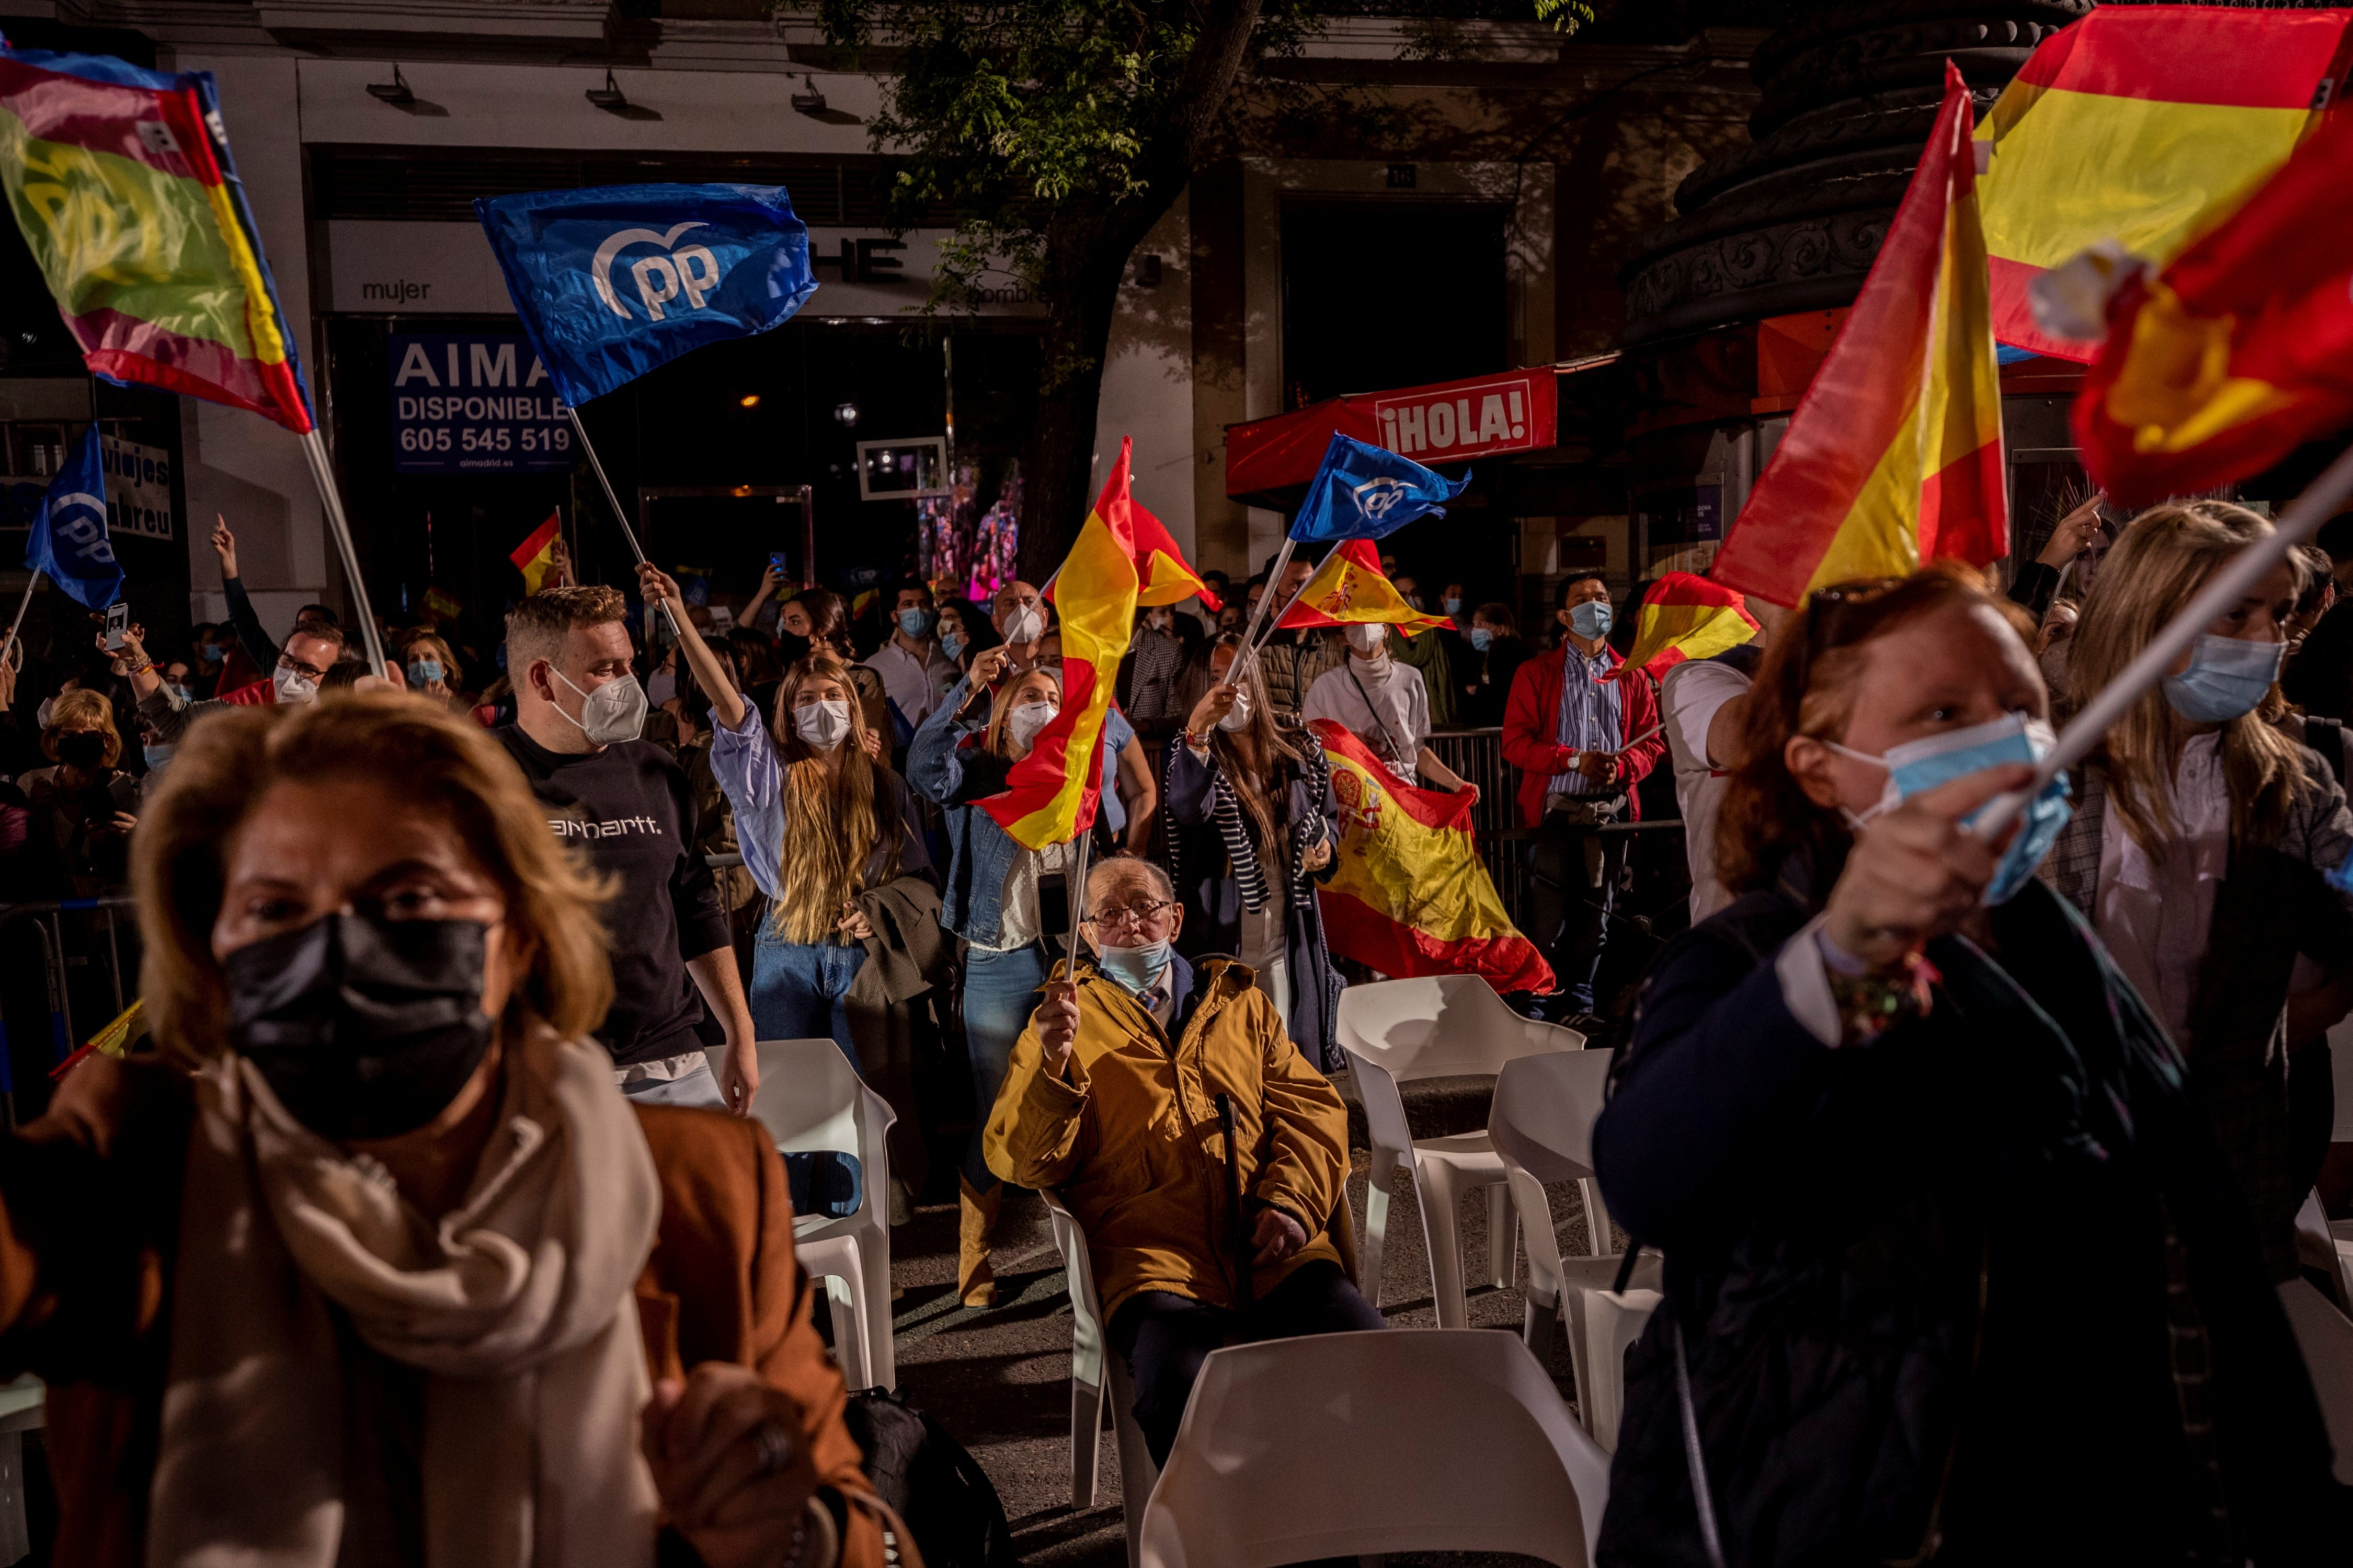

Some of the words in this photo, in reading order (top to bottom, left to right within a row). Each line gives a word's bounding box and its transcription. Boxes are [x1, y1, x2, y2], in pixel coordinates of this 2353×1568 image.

[1392, 169, 1411, 184] 16
[363, 279, 431, 303] mujer
[398, 396, 569, 420] DISPONIBLE
[1384, 391, 1525, 454] ¡HOLA!
[400, 427, 452, 452] 605
[461, 427, 511, 452] 545
[521, 427, 570, 452] 519
[101, 441, 168, 487] viajes
[106, 493, 169, 534] abreu
[547, 816, 657, 838] arhartt
